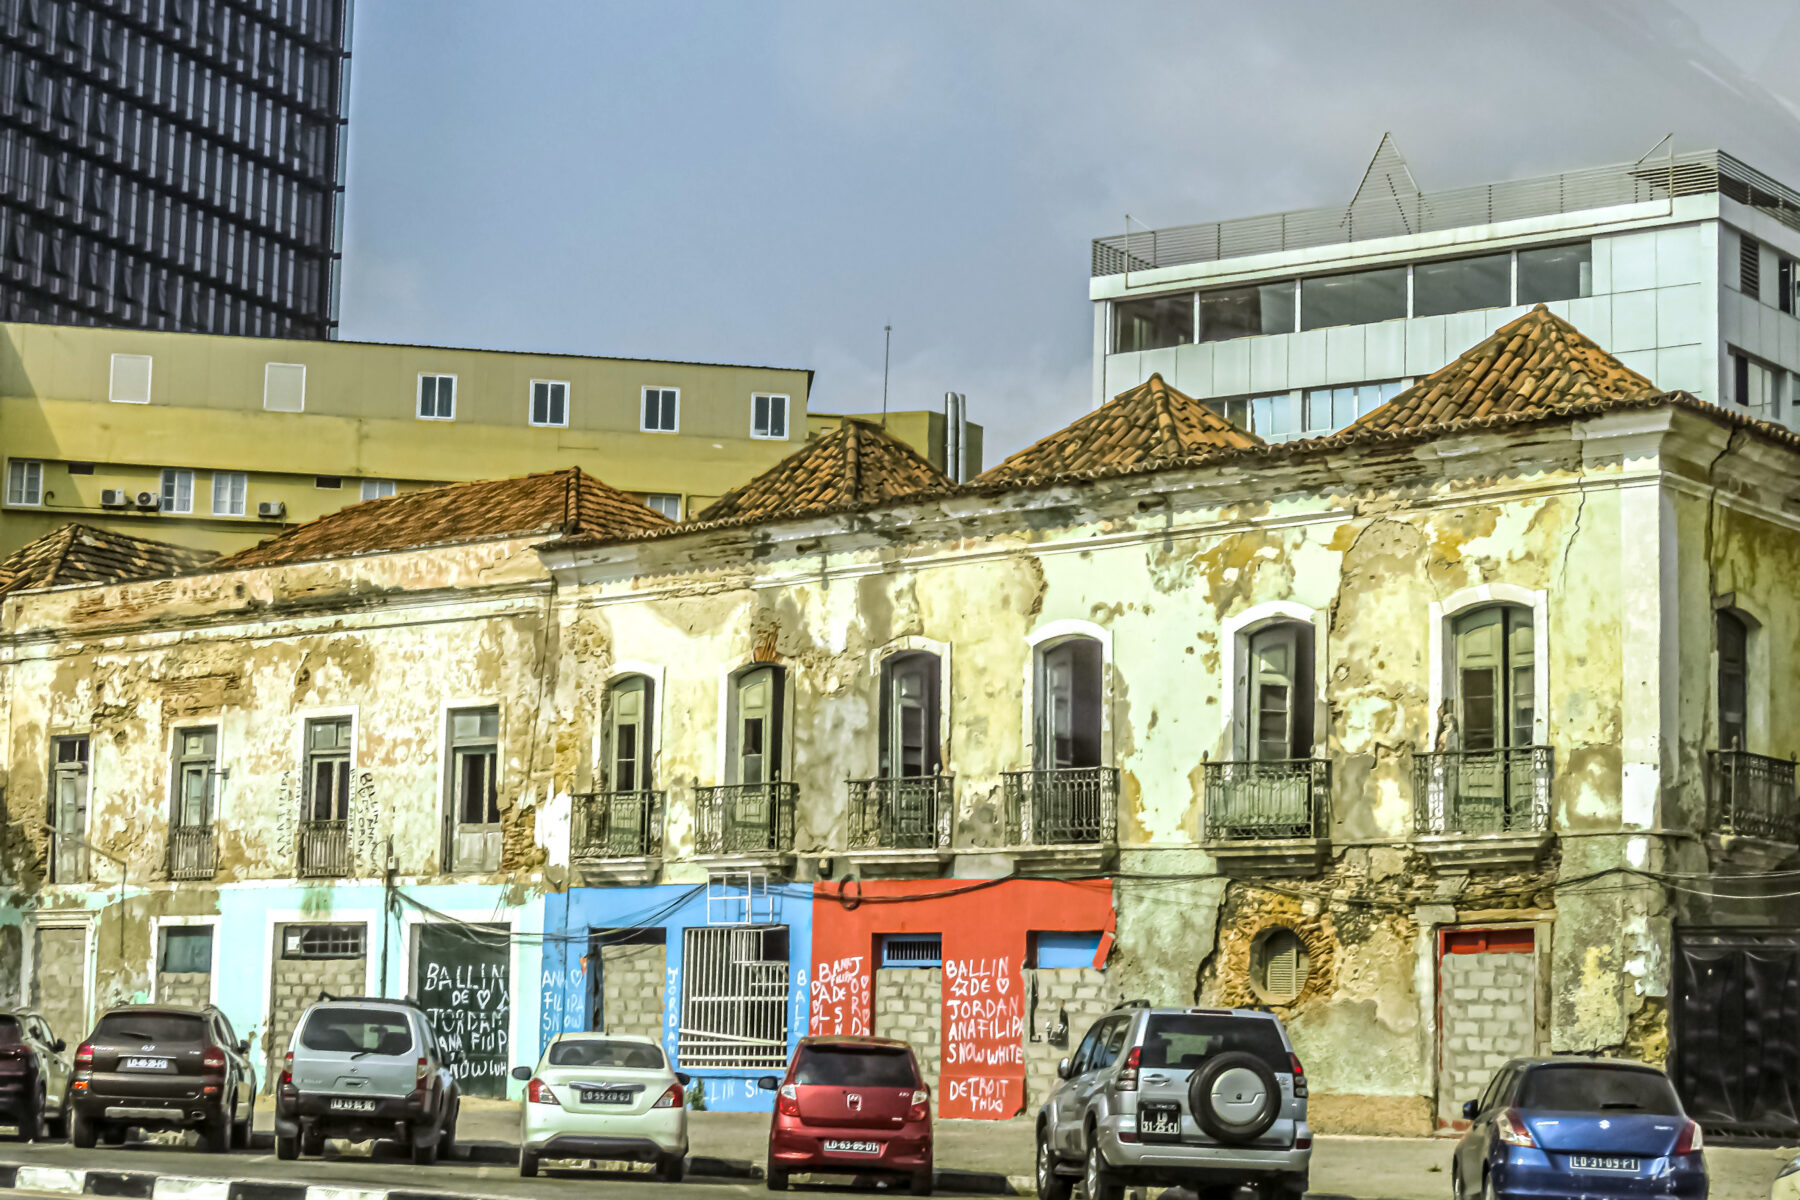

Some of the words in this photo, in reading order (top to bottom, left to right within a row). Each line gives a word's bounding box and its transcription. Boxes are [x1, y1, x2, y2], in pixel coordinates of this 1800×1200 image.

[424, 963, 505, 994] BALLIN
[945, 956, 1010, 980] BALLIN
[452, 989, 470, 1007] DE
[970, 978, 992, 997] DE
[946, 994, 1020, 1021] JORDAN
[949, 1077, 1010, 1101] DETROIT
[970, 1096, 1004, 1114] THUG
